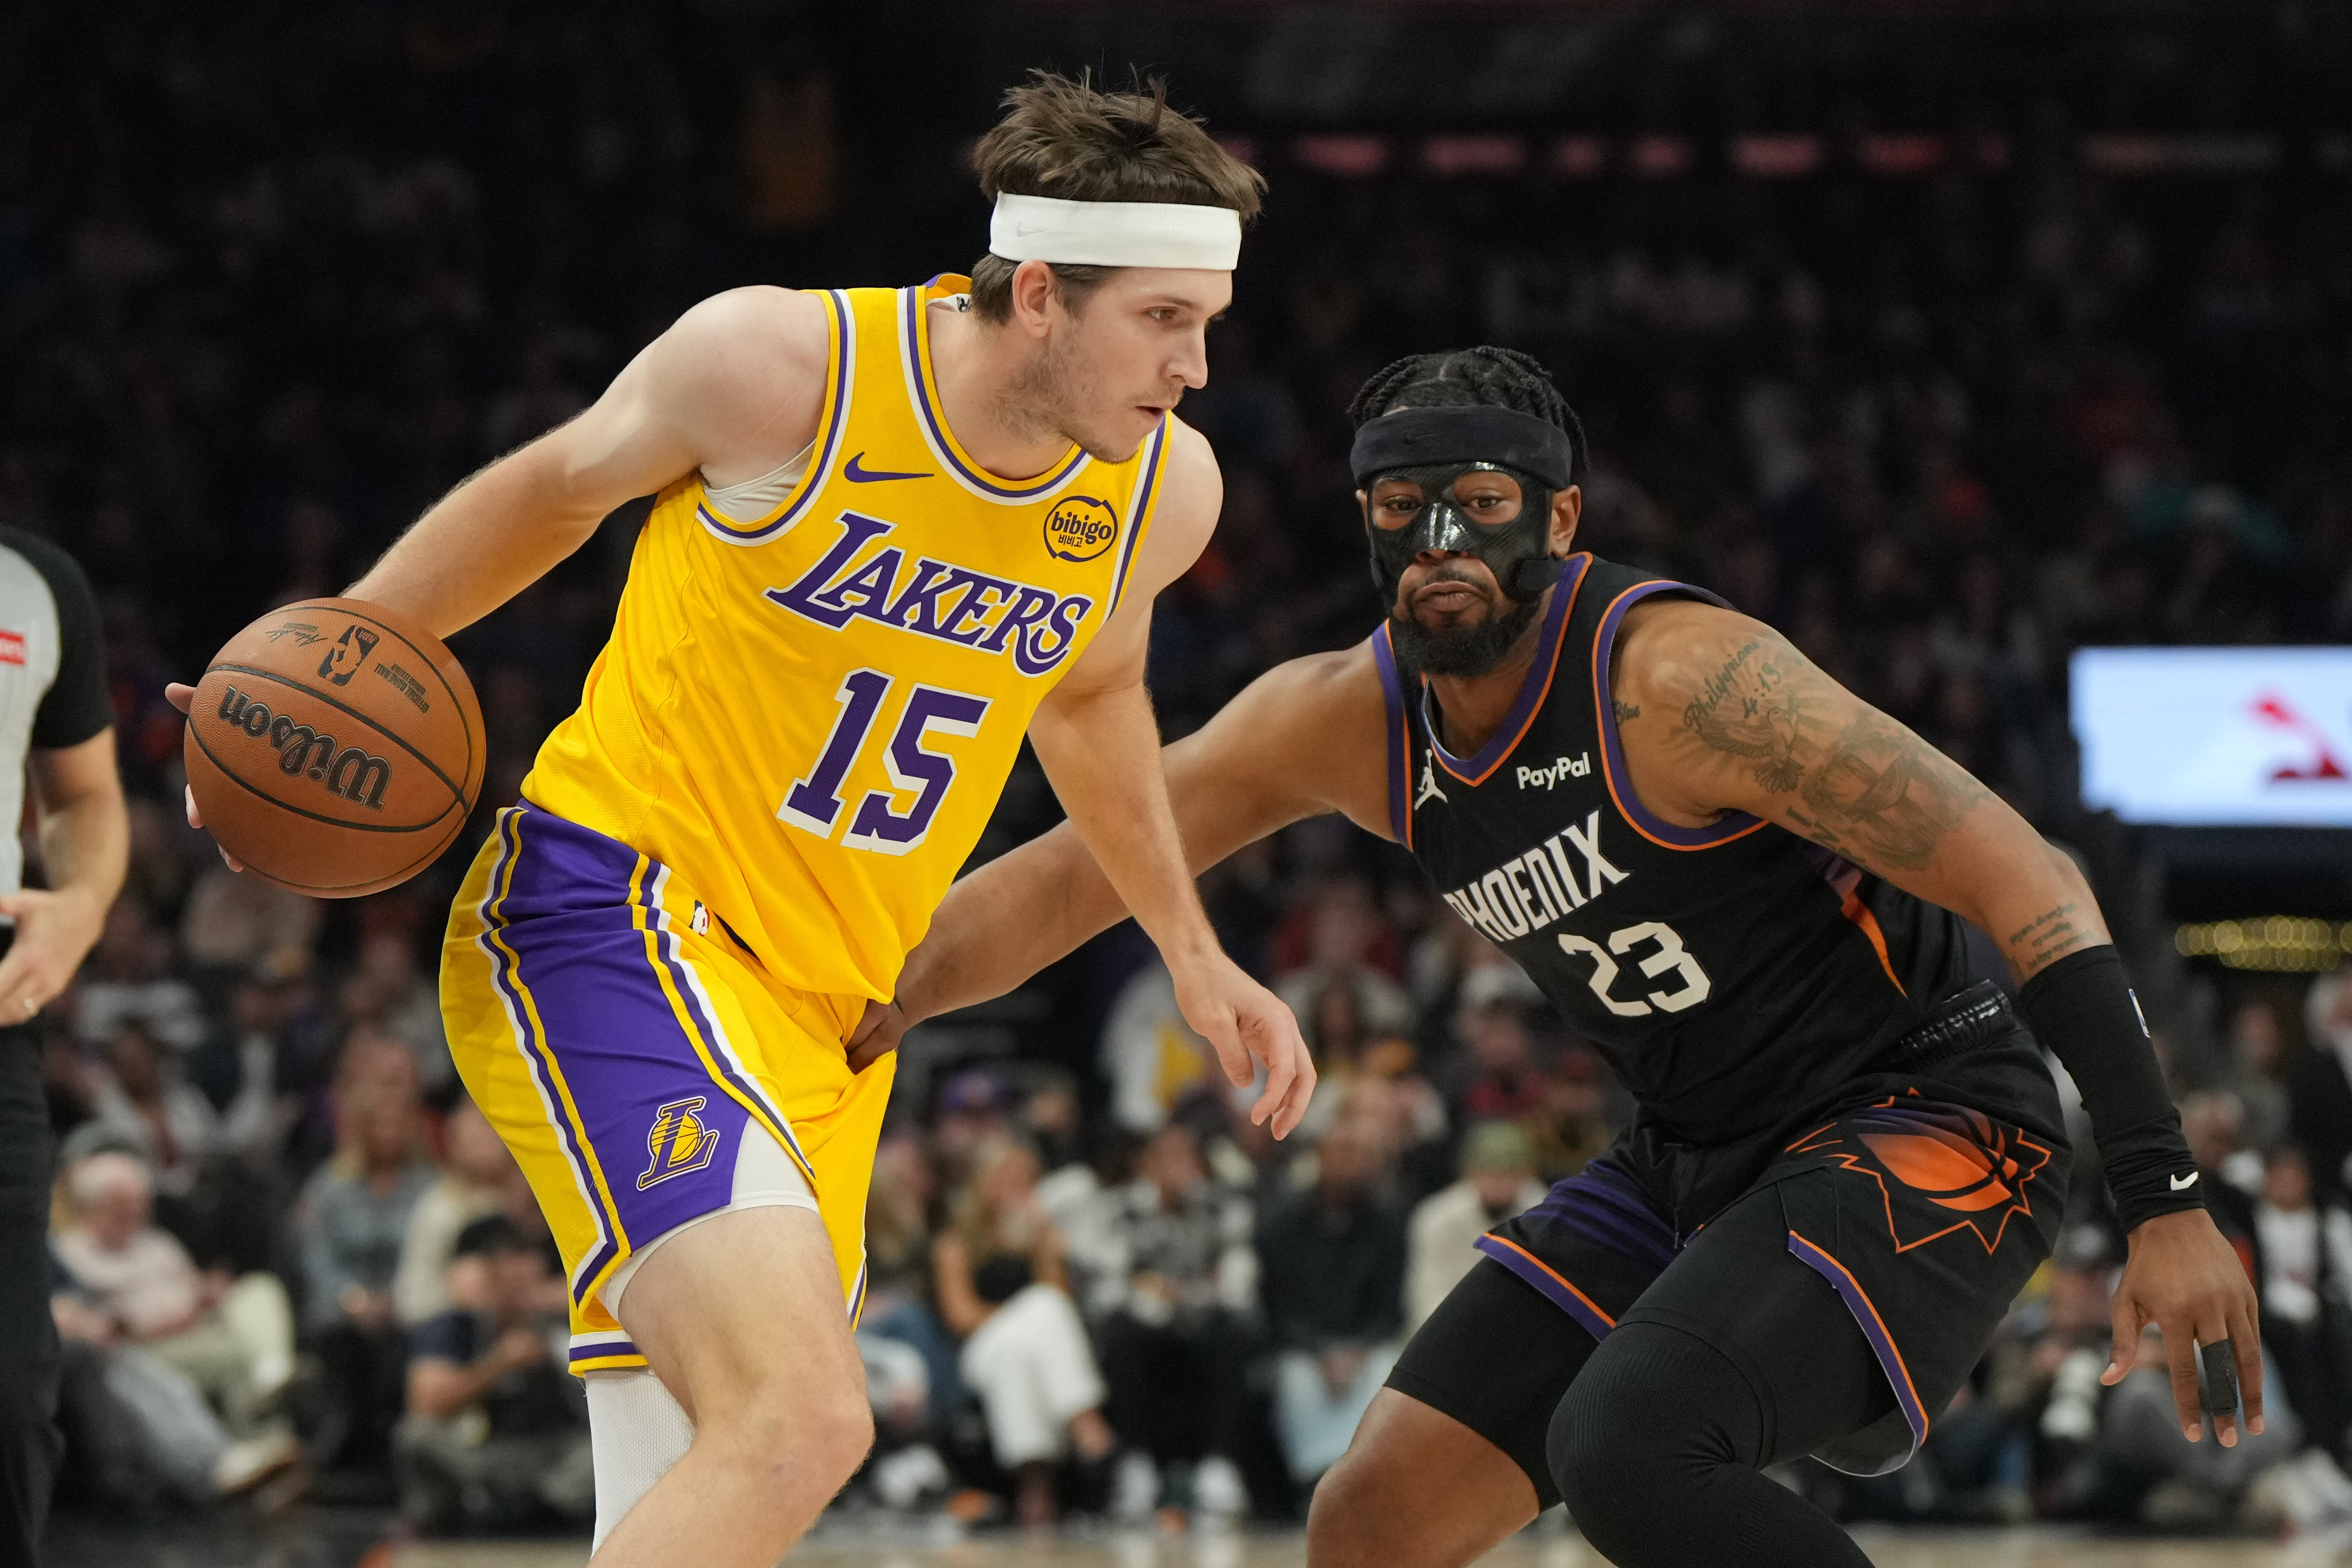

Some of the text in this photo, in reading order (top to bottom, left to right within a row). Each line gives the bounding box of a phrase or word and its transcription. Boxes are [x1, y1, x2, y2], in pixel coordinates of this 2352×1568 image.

[1051, 511, 1112, 545] bibigo
[1058, 534, 1083, 548] 비비고
[761, 508, 1095, 678] LAKERS
[218, 683, 392, 812] Wilson
[776, 666, 994, 857] 15
[1516, 751, 1591, 790] PayPal
[1558, 921, 1712, 1017] 23
